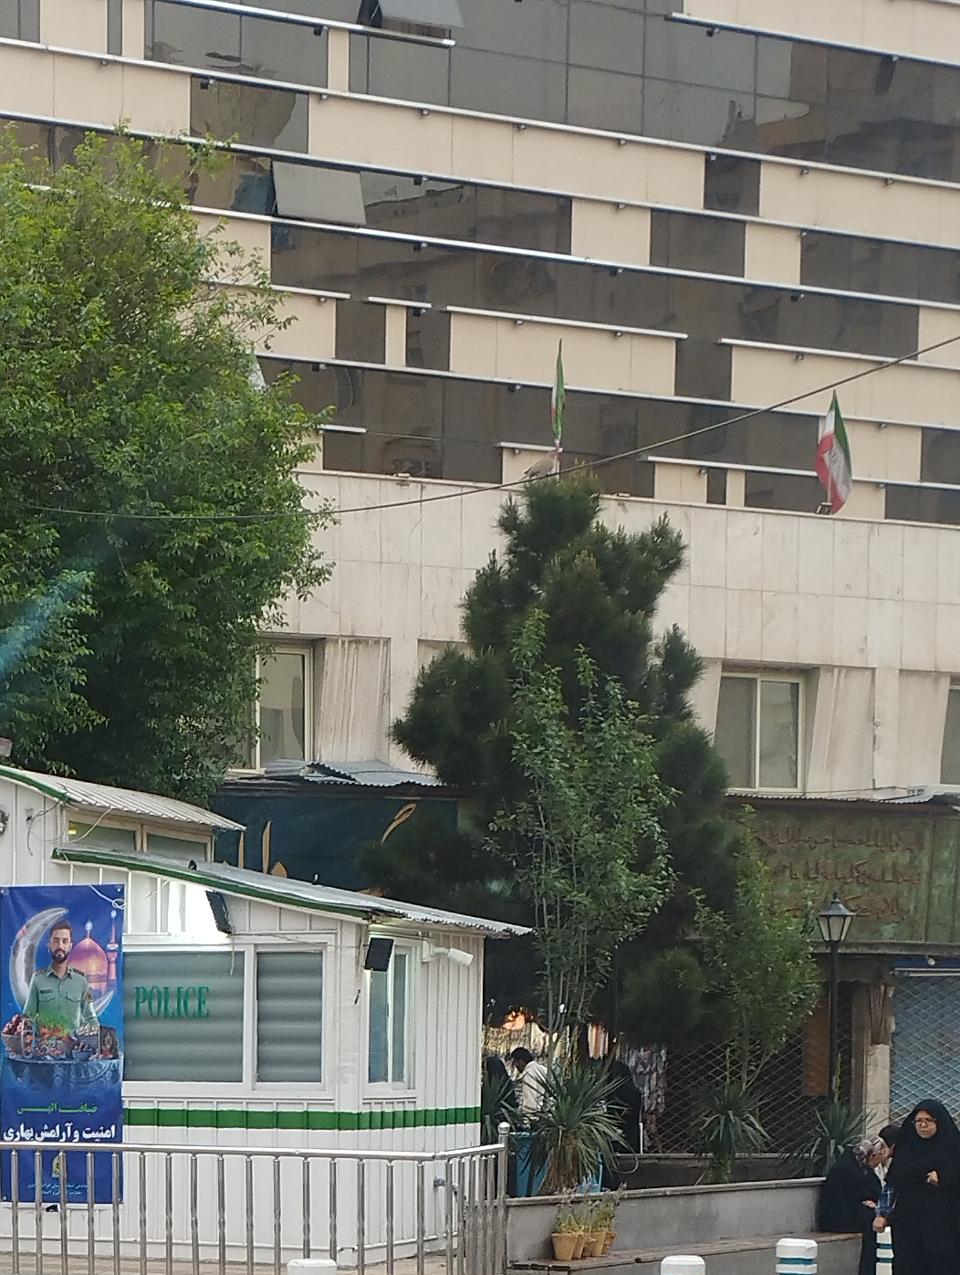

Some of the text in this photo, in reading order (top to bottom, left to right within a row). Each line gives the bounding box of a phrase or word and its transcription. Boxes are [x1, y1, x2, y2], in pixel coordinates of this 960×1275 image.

[133, 986, 210, 1019] POLICE
[3, 1122, 34, 1142] بهاری
[82, 1124, 116, 1142] امنیت
